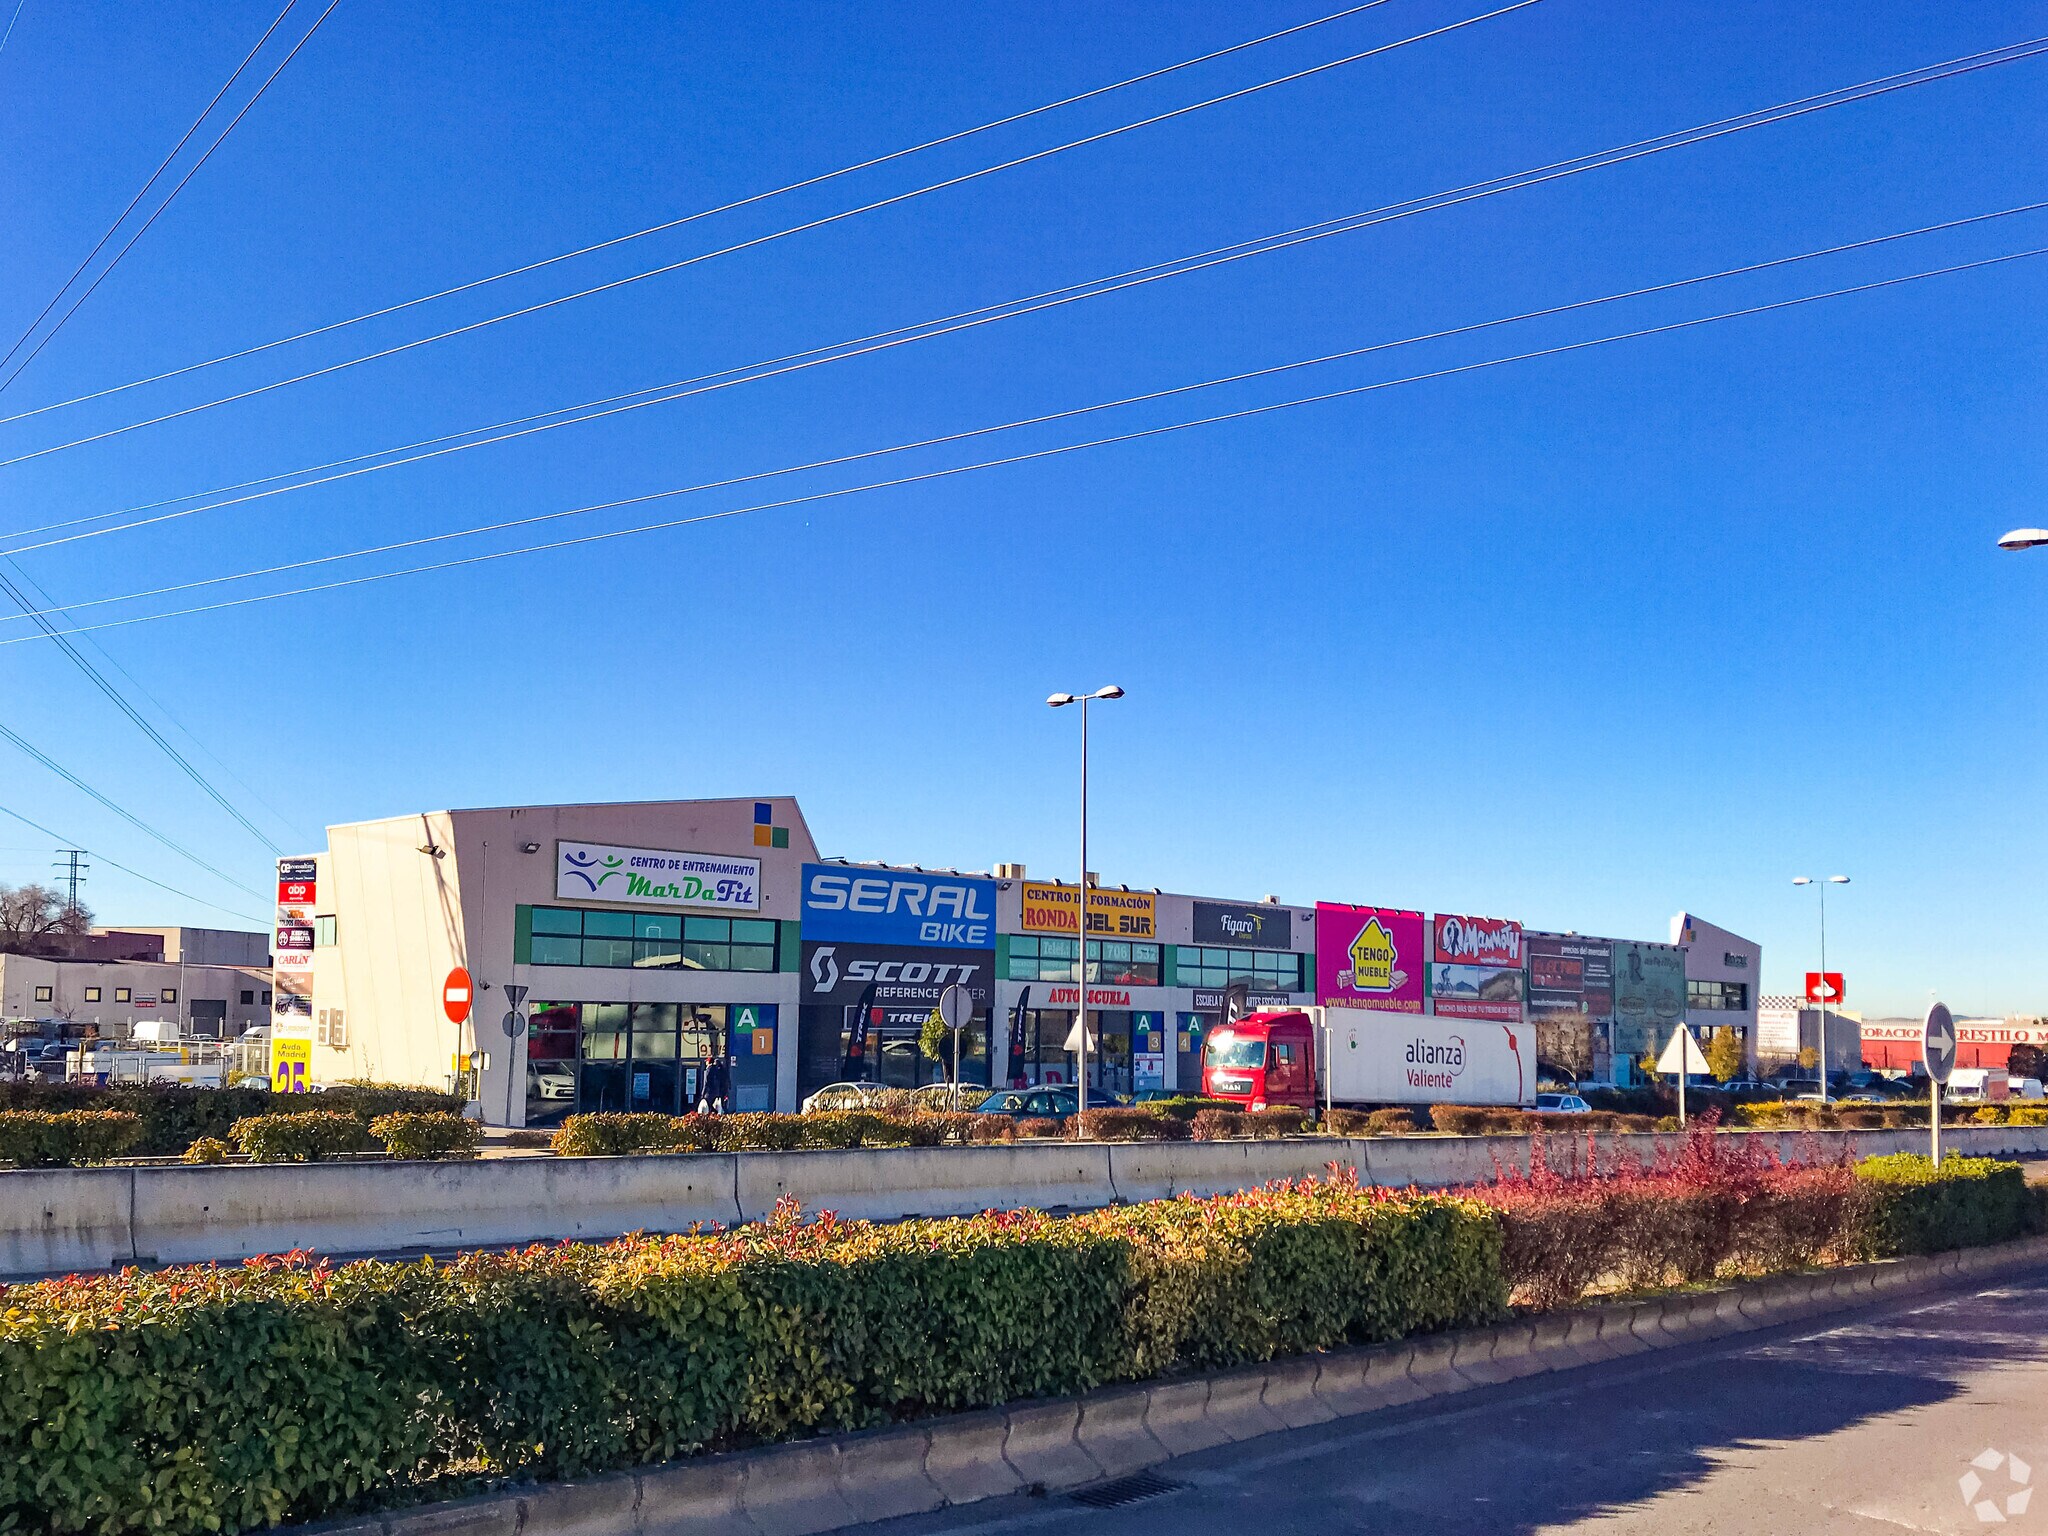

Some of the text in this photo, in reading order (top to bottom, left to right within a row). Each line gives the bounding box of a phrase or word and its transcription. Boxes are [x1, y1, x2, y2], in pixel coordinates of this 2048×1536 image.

[630, 856, 755, 876] CENTRO DE ENTRENAMIENTO
[287, 883, 307, 897] abp
[625, 872, 753, 904] MarDaFit
[807, 874, 990, 920] SERAL
[1026, 889, 1151, 910] CENTRO D FORMACIÓN
[1025, 907, 1079, 928] RONDA
[1119, 915, 1152, 934] SUR
[919, 922, 988, 944] BIKE
[1107, 944, 1128, 958] 706
[1357, 947, 1389, 962] TENGO
[842, 960, 981, 985] SCOTT
[1358, 966, 1388, 978] MUEBLE
[876, 986, 939, 999] REFERENCE
[1049, 988, 1131, 1006] AUTOSCUELA
[1196, 994, 1219, 1007] ESCUELA
[1245, 995, 1261, 1008] ARTES
[1325, 997, 1421, 1010] www.tengomueble.com
[737, 1008, 757, 1028] A
[1137, 1015, 1150, 1031] A
[1188, 1017, 1200, 1032] A
[758, 1035, 766, 1049] 1
[1151, 1037, 1159, 1048] 3
[1180, 1037, 1187, 1048] 4
[1956, 1028, 2030, 1042] RESTILO
[278, 1051, 306, 1059] Madrid
[1406, 1038, 1462, 1066] alianza
[277, 1061, 305, 1094] 25
[1406, 1068, 1453, 1088] Valiente
[1222, 1083, 1242, 1092] MAN
